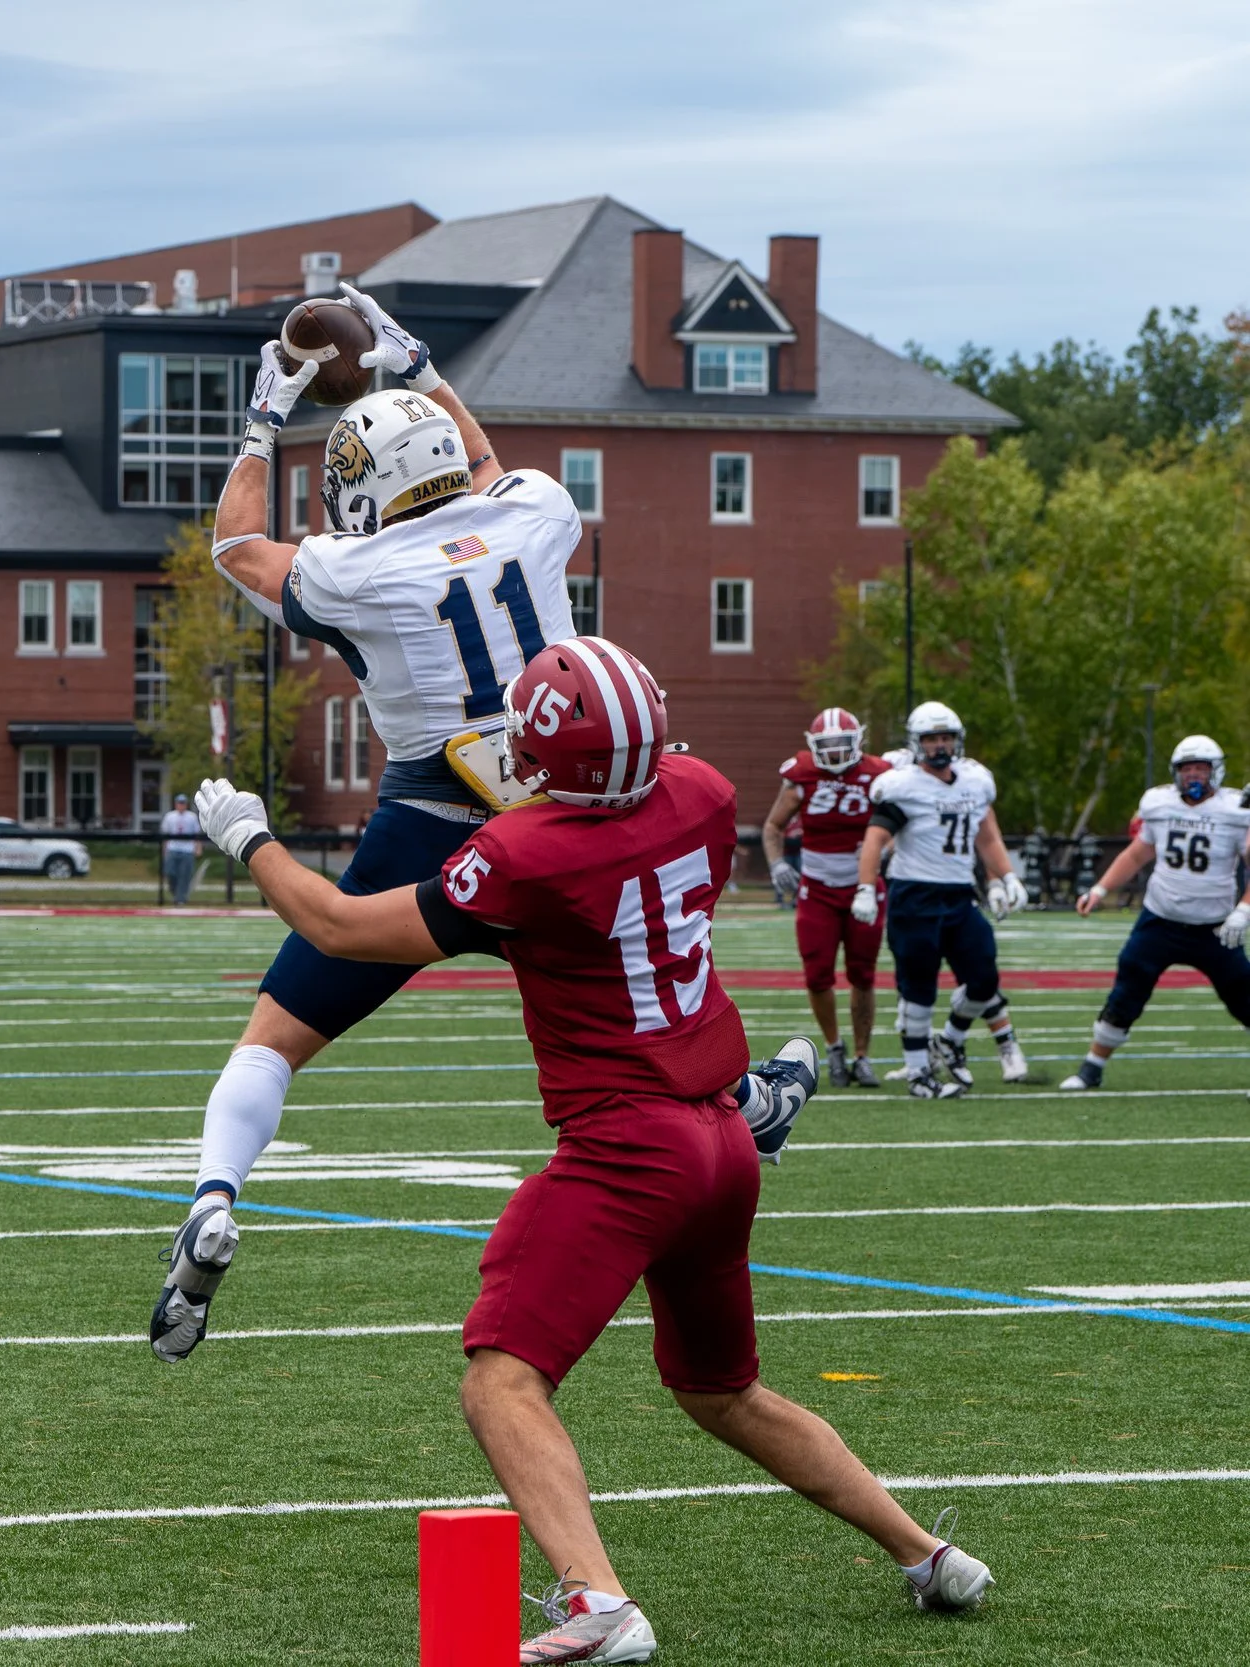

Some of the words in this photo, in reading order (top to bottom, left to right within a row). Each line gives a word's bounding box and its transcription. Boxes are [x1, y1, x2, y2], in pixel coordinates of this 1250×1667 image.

[393, 394, 437, 423] 11
[433, 556, 548, 724] 11
[524, 681, 571, 737] 15
[591, 771, 604, 784] 15
[940, 812, 971, 856] 71
[1165, 830, 1211, 874] 56
[446, 846, 492, 904] 15
[608, 844, 713, 1034] 15
